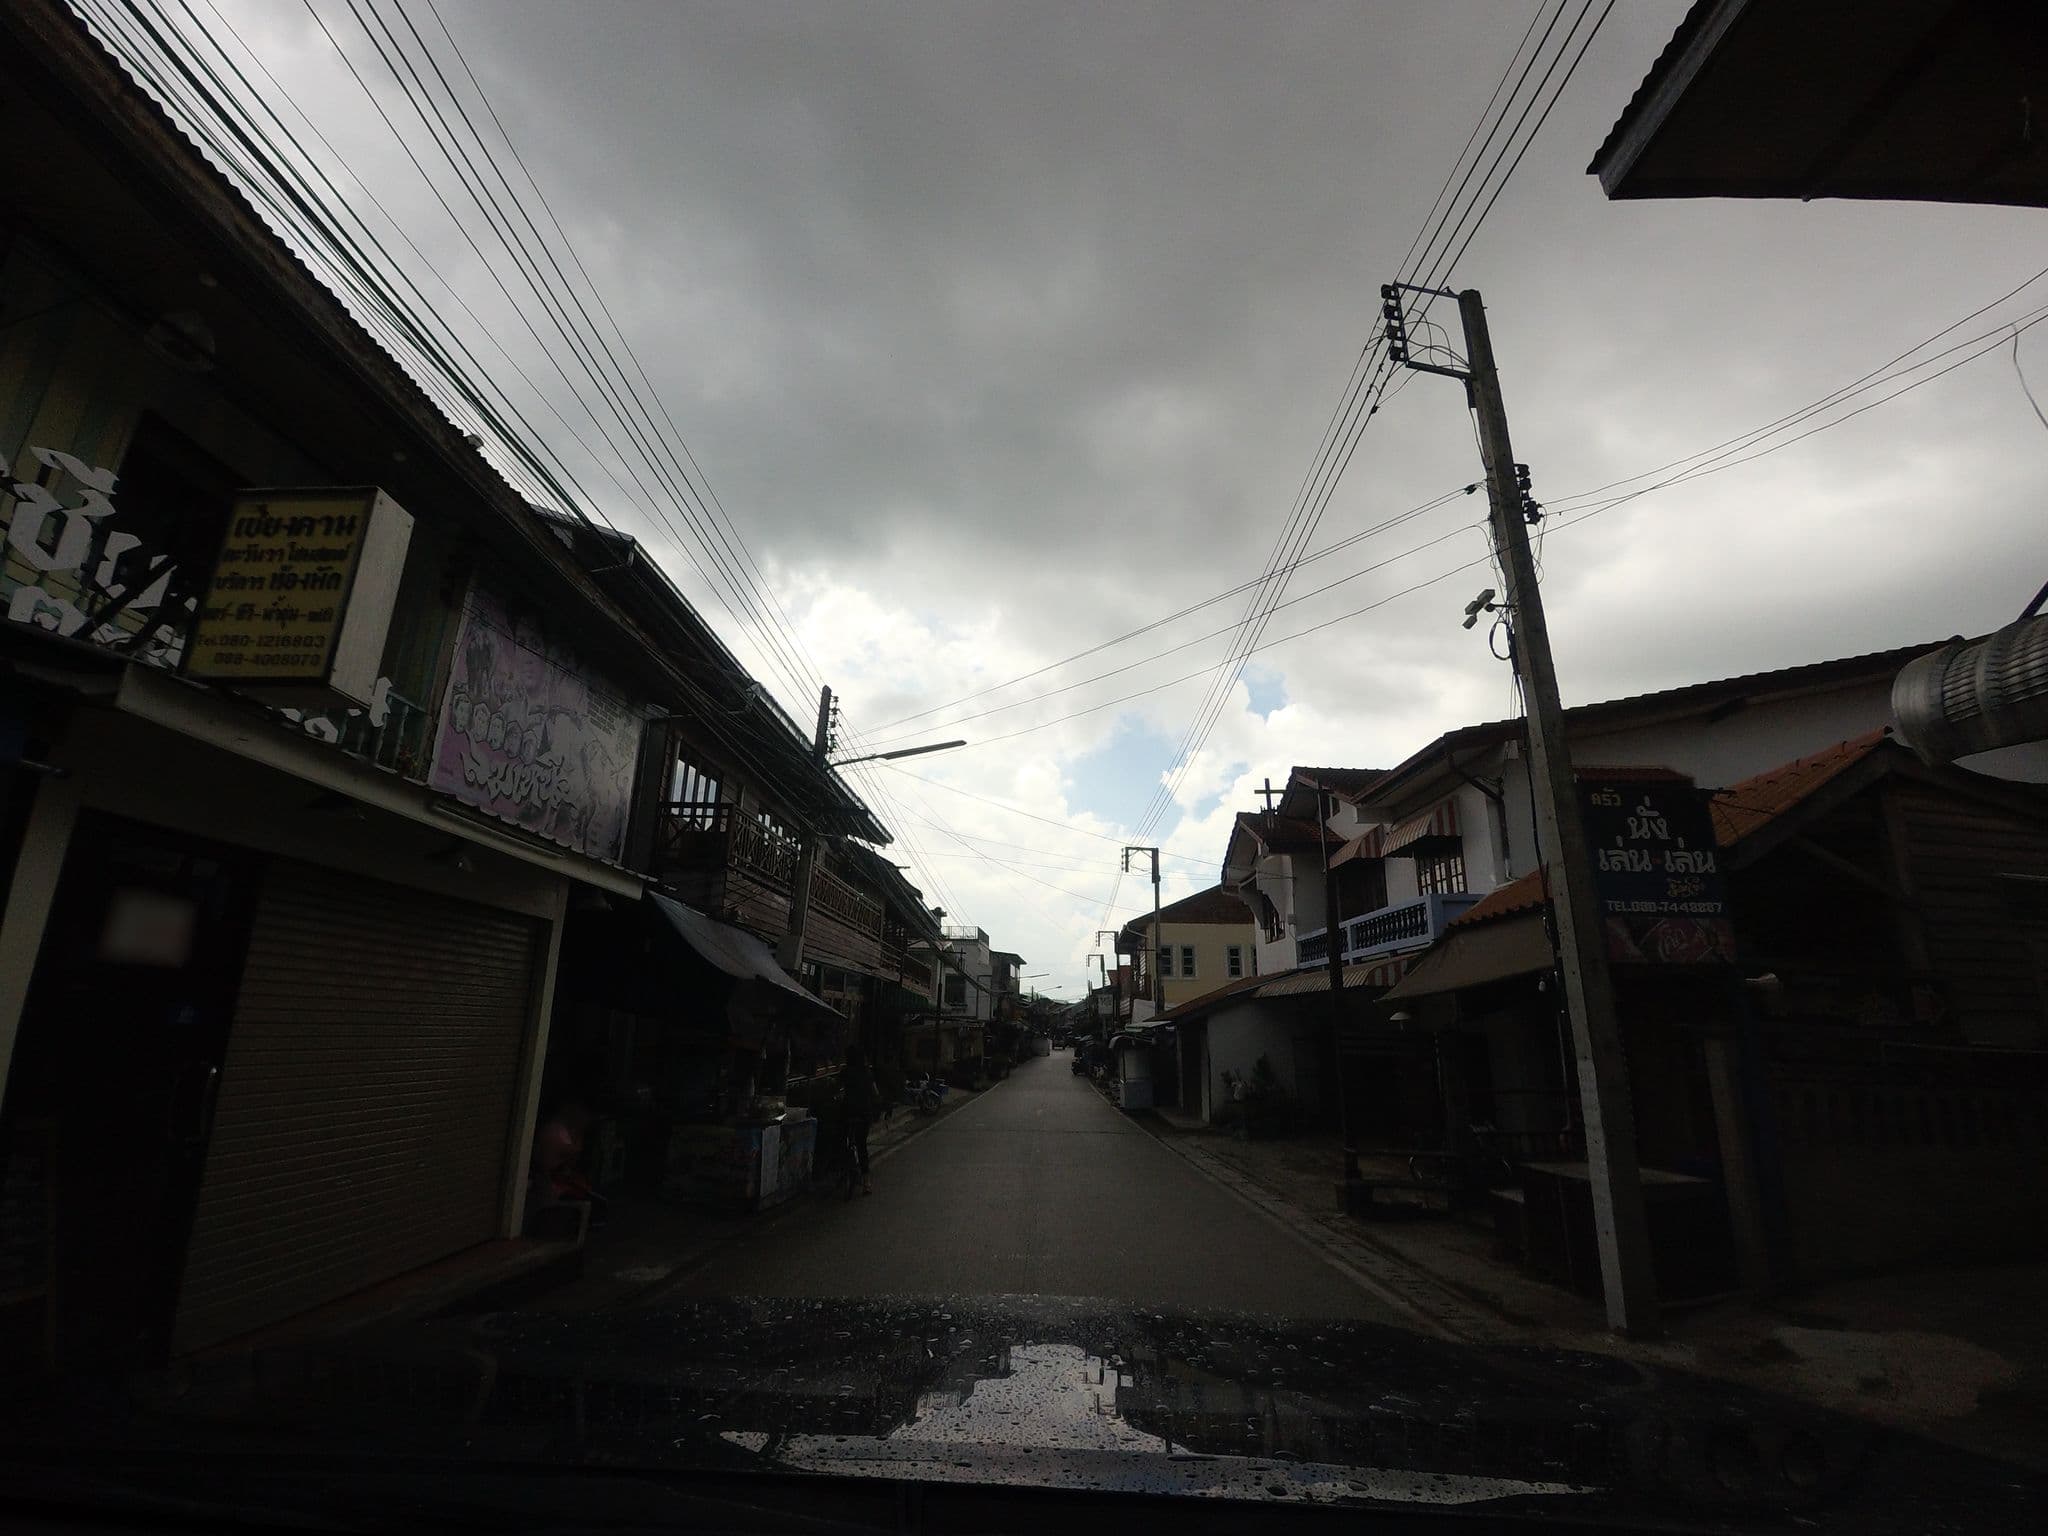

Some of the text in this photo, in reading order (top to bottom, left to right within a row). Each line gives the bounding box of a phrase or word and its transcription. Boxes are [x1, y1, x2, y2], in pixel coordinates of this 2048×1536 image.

[270, 564, 343, 592] ห้องพัก
[1626, 794, 1672, 840] นั่ง
